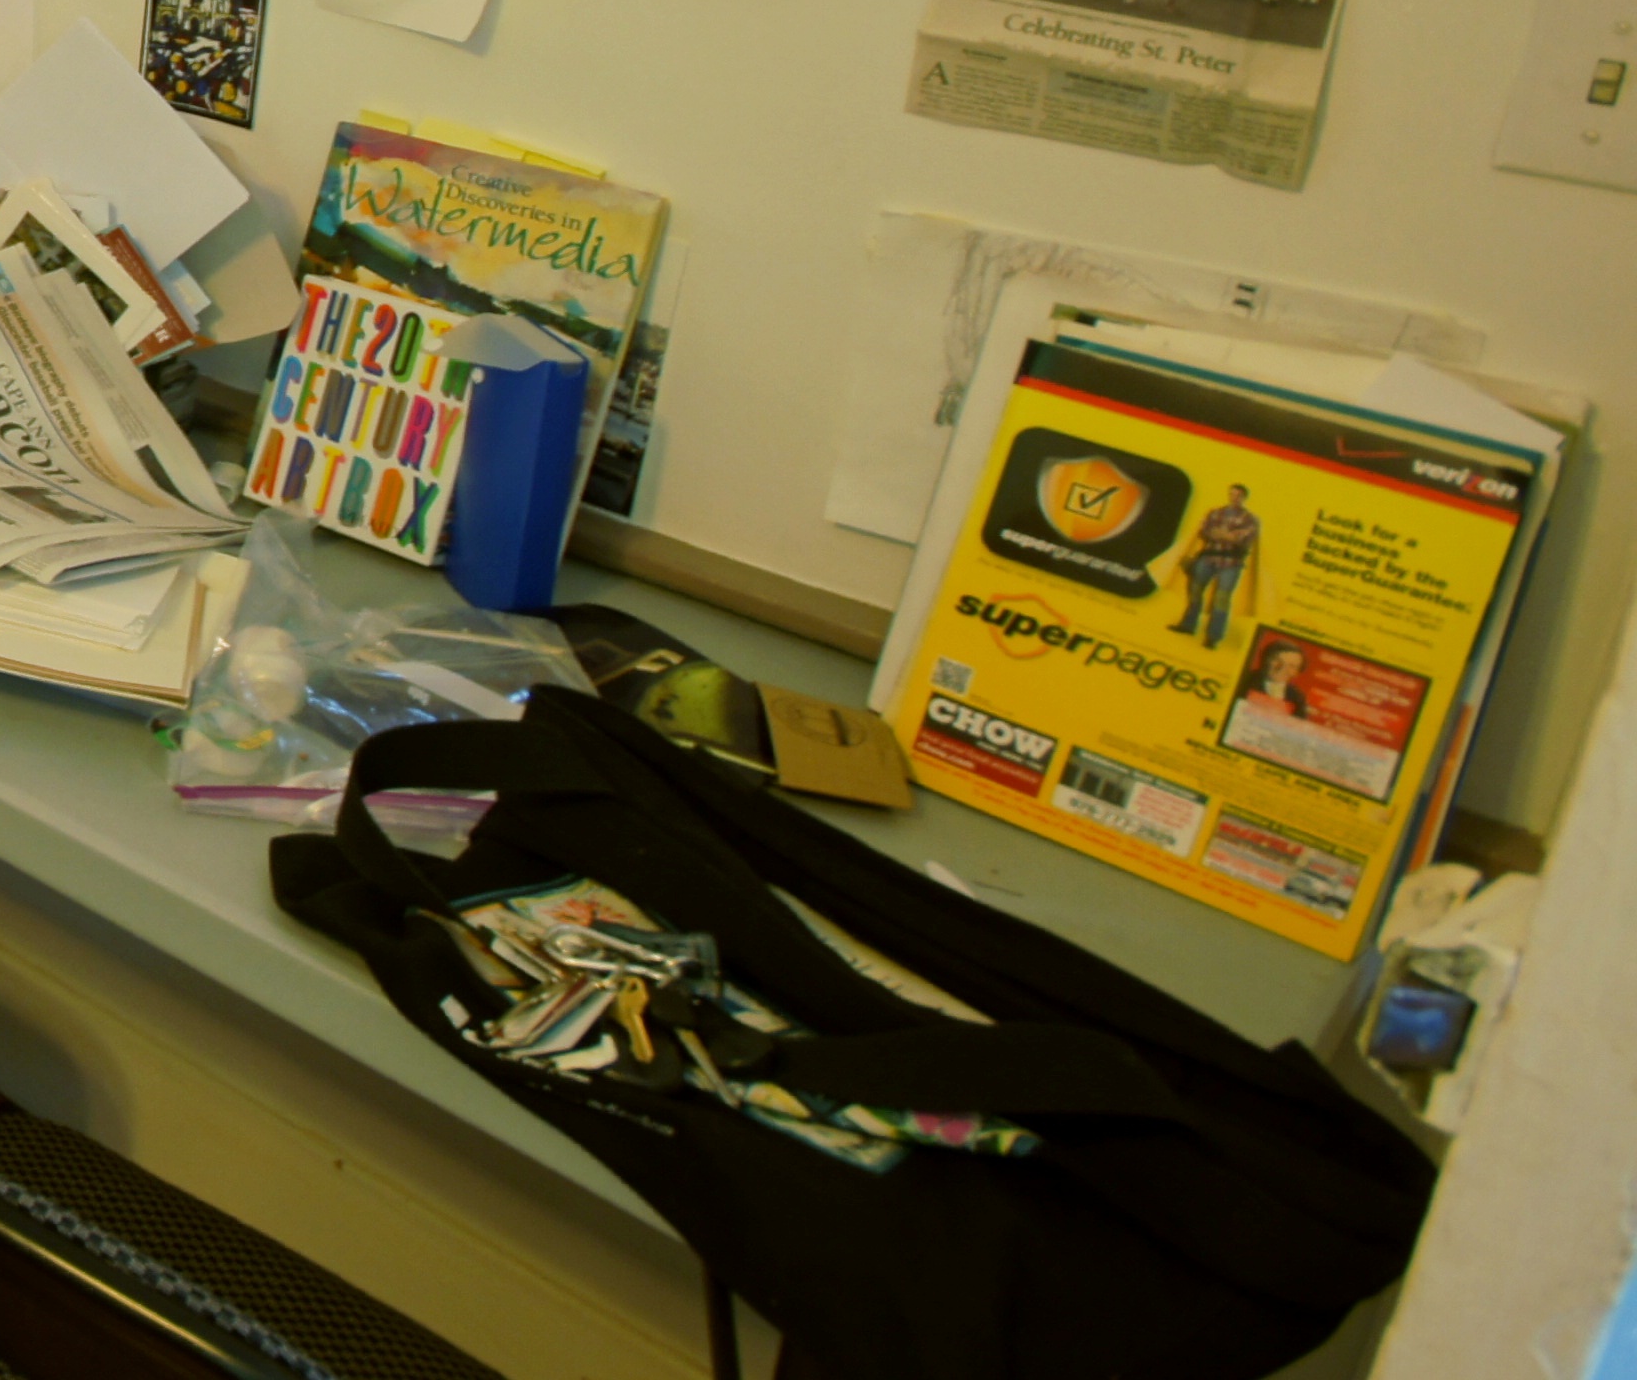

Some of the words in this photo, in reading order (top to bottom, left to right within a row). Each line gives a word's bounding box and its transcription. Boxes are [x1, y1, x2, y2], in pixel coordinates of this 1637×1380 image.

[1002, 11, 1134, 59] Celebrating
[1175, 46, 1237, 76] Peter
[443, 182, 559, 227] Discoveries
[562, 211, 582, 232] in
[451, 163, 533, 197] Creative
[341, 163, 642, 288] Watermedia
[294, 281, 373, 371] THE
[29, 361, 58, 408] baseball
[51, 406, 74, 442] preps
[34, 338, 69, 397] biography
[64, 396, 90, 439] debuts
[271, 354, 462, 478] CENTURY
[24, 416, 54, 449] ANN
[249, 427, 347, 517] ART
[337, 453, 442, 555] BOX
[1412, 459, 1519, 501] verizon
[1312, 523, 1400, 559] business
[1317, 507, 1364, 532] Look
[1372, 524, 1399, 542] for
[1405, 538, 1418, 548] a
[1307, 537, 1380, 569] backed
[1384, 560, 1408, 580] by
[1415, 570, 1449, 590] the
[954, 593, 1222, 702] superpages
[928, 697, 1055, 761] CHOW
